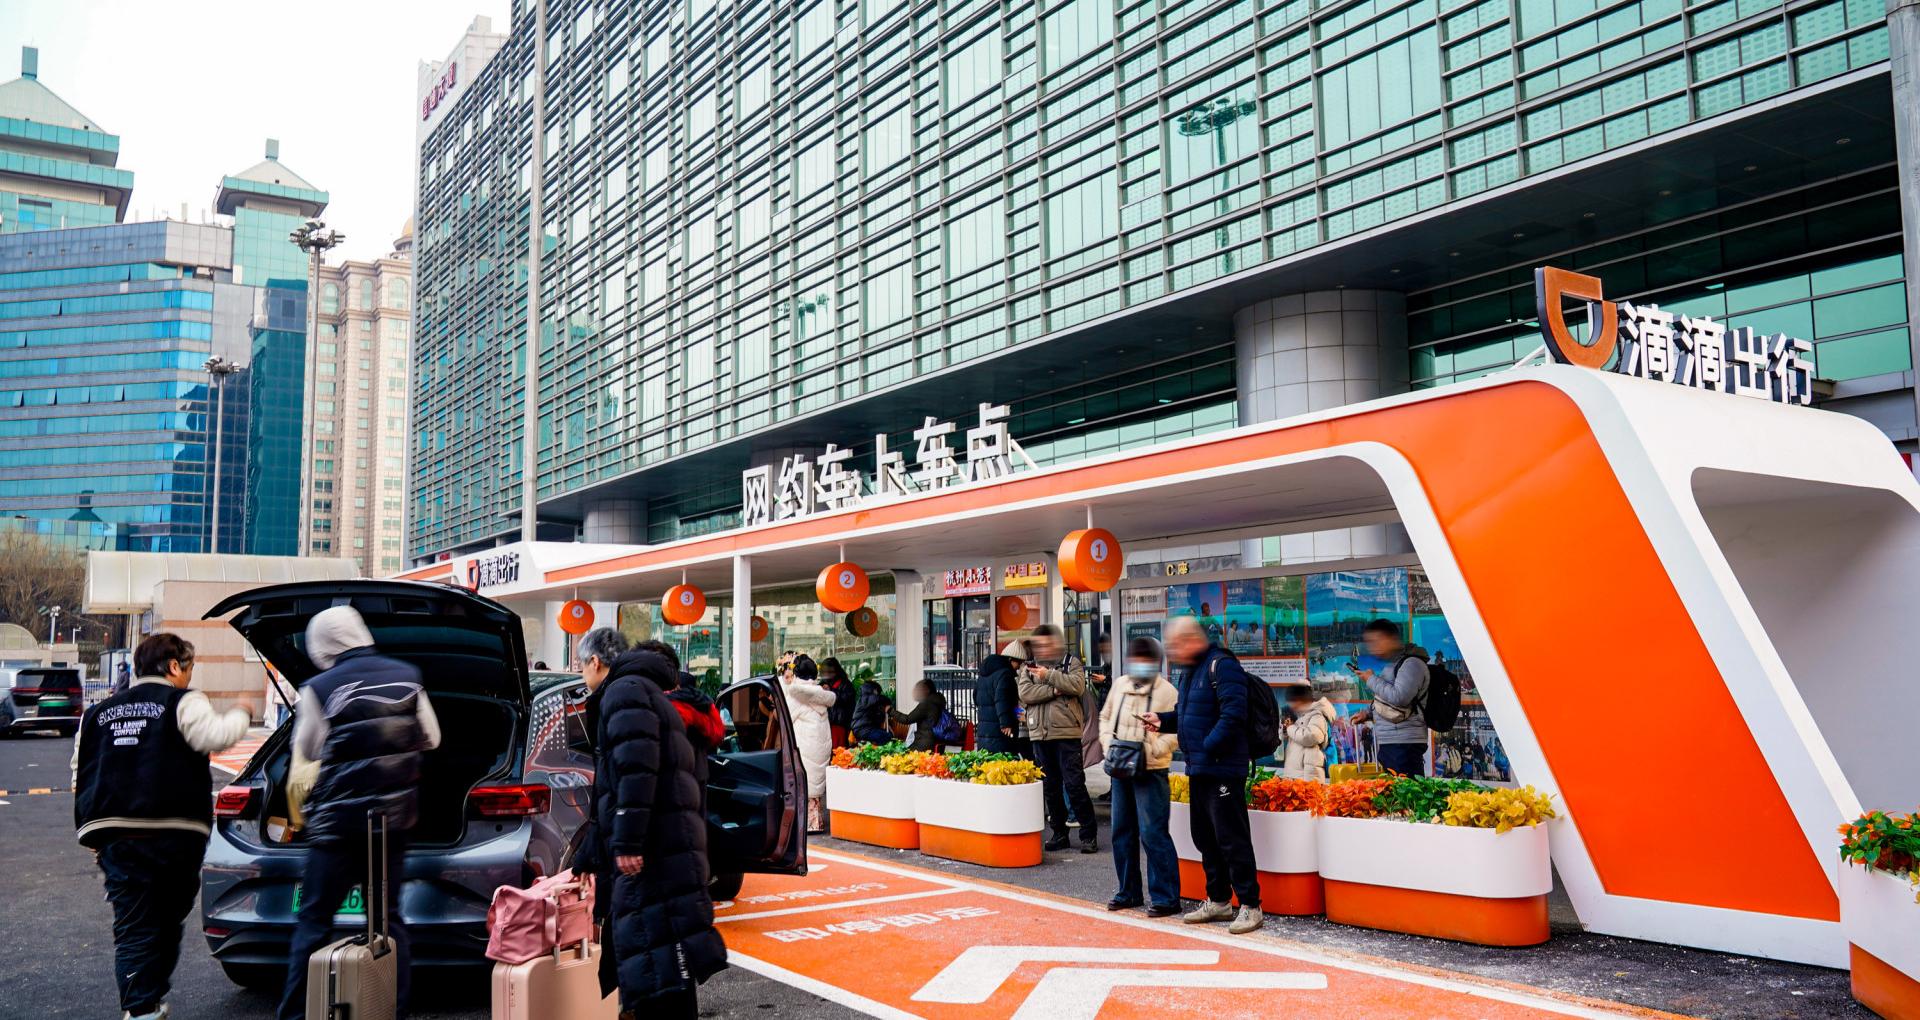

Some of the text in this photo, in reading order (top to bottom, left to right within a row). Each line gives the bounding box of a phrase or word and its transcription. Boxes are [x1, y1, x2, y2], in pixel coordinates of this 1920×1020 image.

[1618, 301, 1815, 406] 滴滴出行
[742, 402, 1015, 527] 网约车上车点
[1095, 543, 1102, 559] 1
[479, 551, 520, 588] 滴滴出行
[844, 574, 851, 585] 2
[97, 702, 165, 726] SKECHERS
[110, 719, 147, 730] ALL AROUND
[114, 728, 141, 737] COMFORT
[762, 905, 1000, 943] 即停即走
